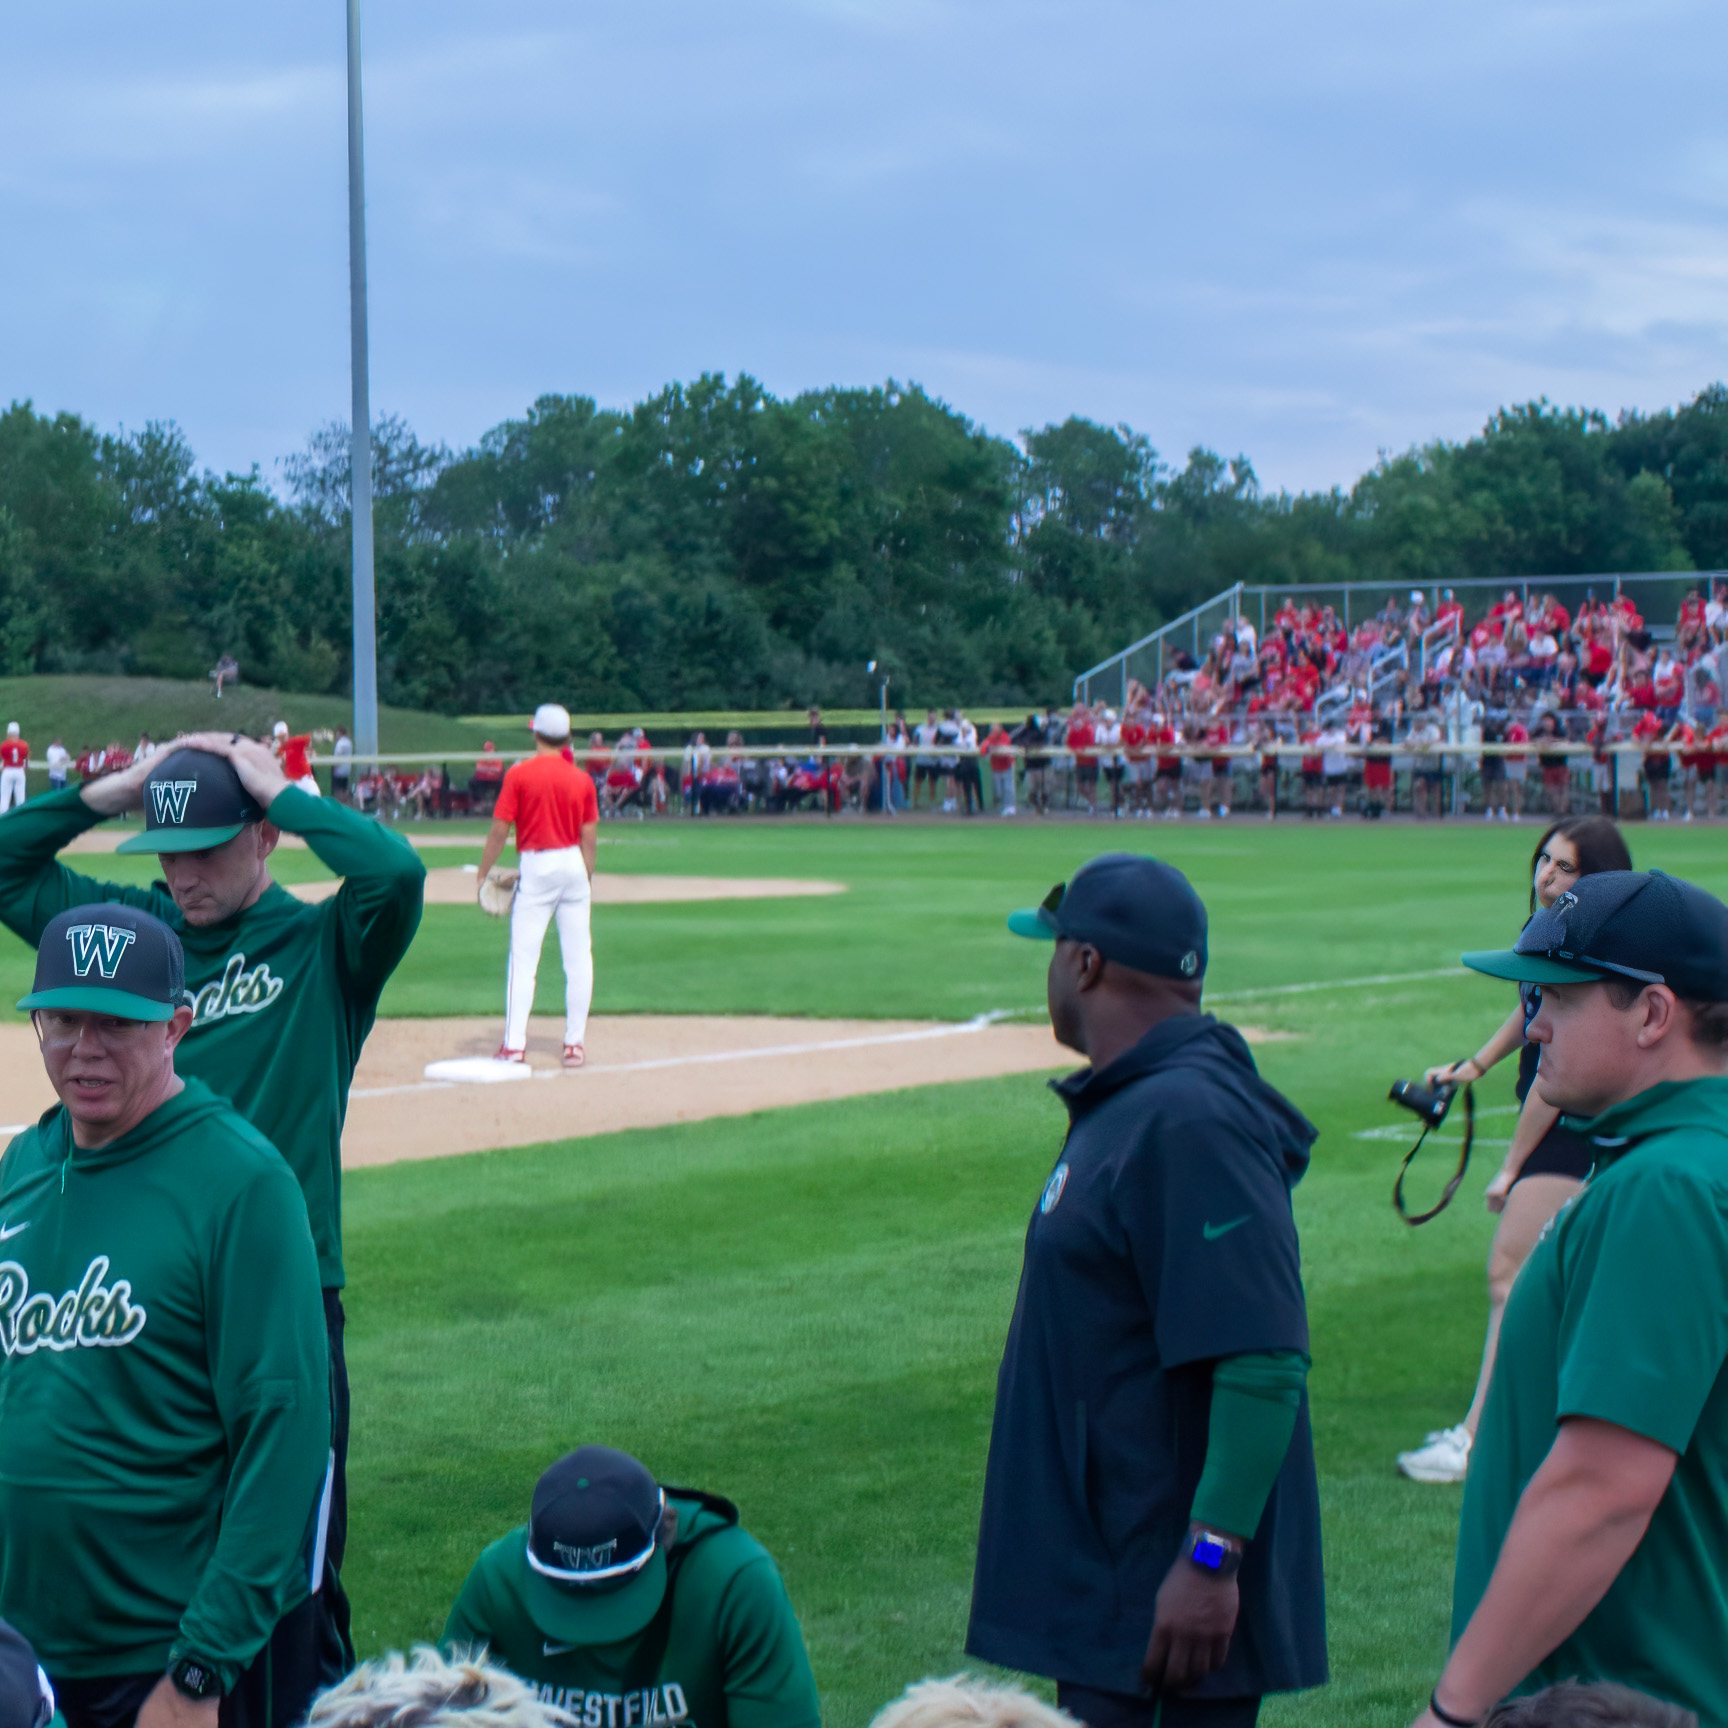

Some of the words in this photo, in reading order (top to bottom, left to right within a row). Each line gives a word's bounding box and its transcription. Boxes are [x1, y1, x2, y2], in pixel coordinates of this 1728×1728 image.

[150, 780, 197, 824] W
[66, 924, 136, 979] W
[183, 952, 284, 1027] cks
